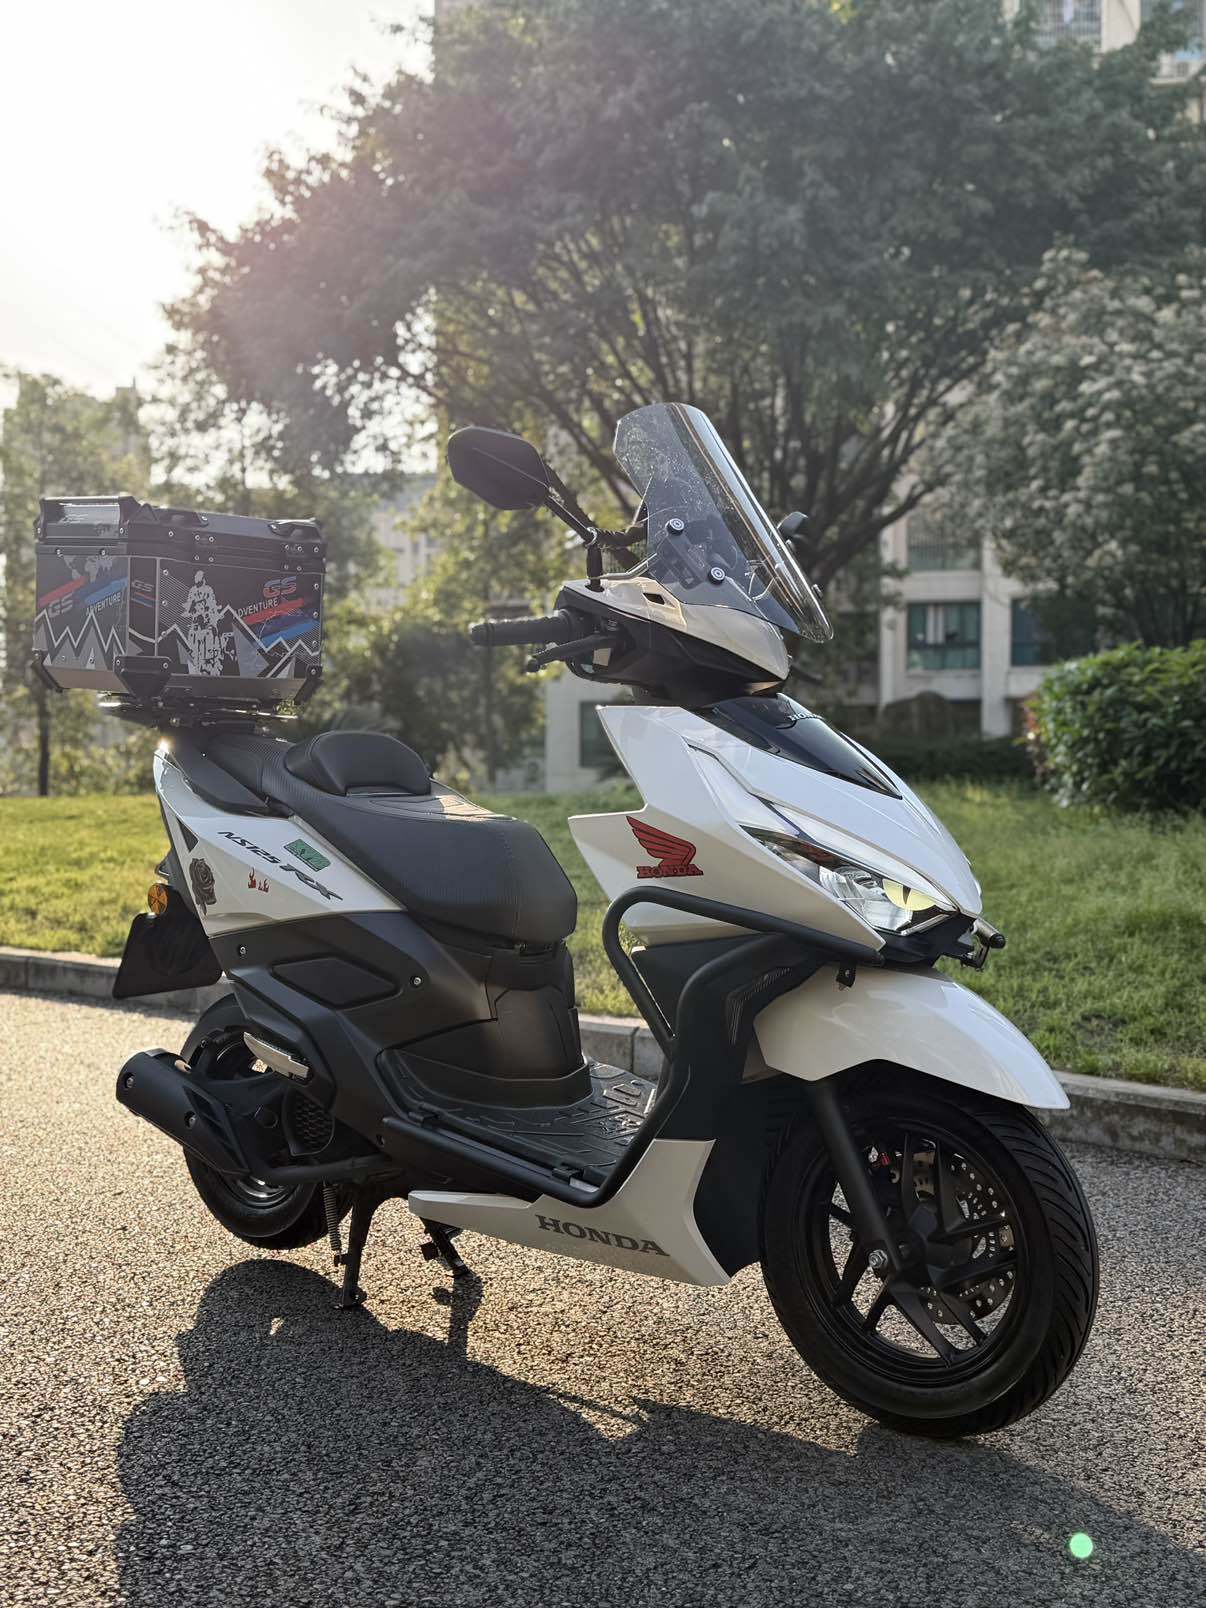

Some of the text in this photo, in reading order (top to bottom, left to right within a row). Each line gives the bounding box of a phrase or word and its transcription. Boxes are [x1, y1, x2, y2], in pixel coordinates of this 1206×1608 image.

[131, 580, 155, 592] GS
[263, 576, 297, 598] GS
[48, 592, 73, 618] GS
[637, 864, 704, 878] HONDA
[535, 1214, 670, 1257] HONDA
